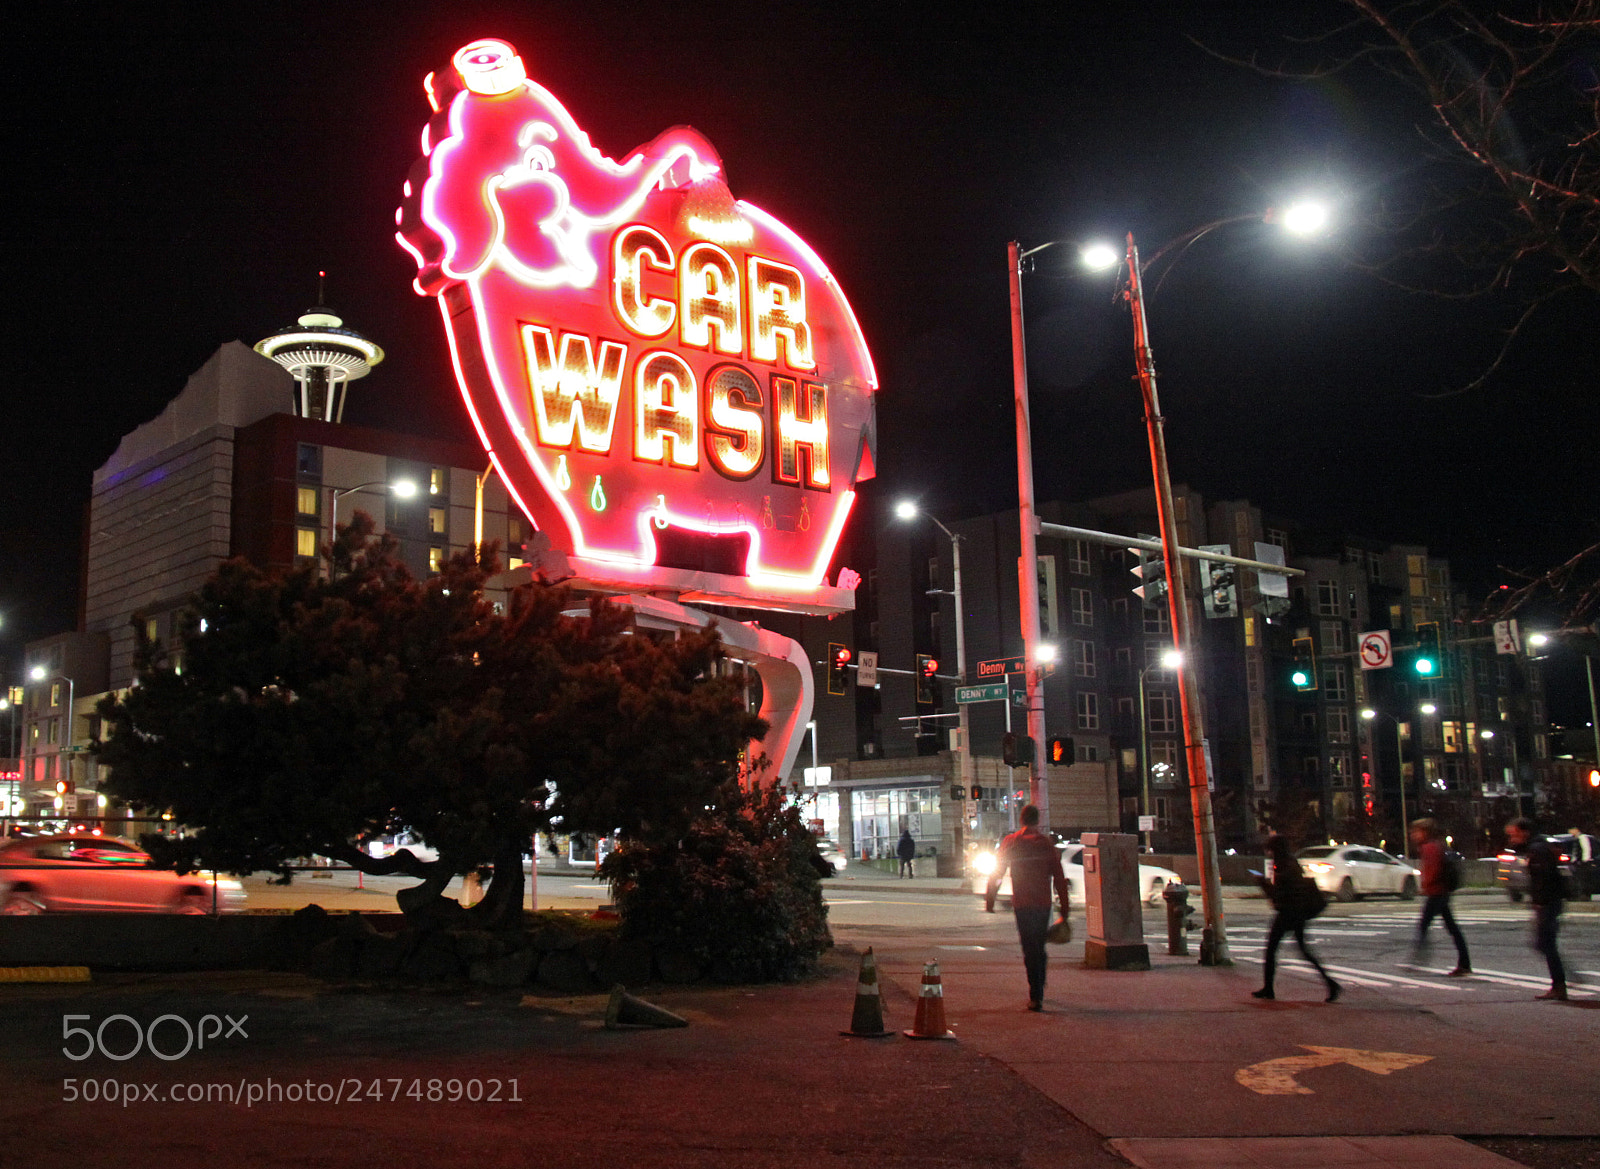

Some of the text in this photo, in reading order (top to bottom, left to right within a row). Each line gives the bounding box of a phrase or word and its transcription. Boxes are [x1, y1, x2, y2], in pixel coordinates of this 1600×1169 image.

[611, 224, 816, 373] CAR
[519, 320, 830, 490] WASH
[863, 658, 873, 668] NO
[980, 662, 1006, 674] Denny
[960, 688, 987, 699] DENNY
